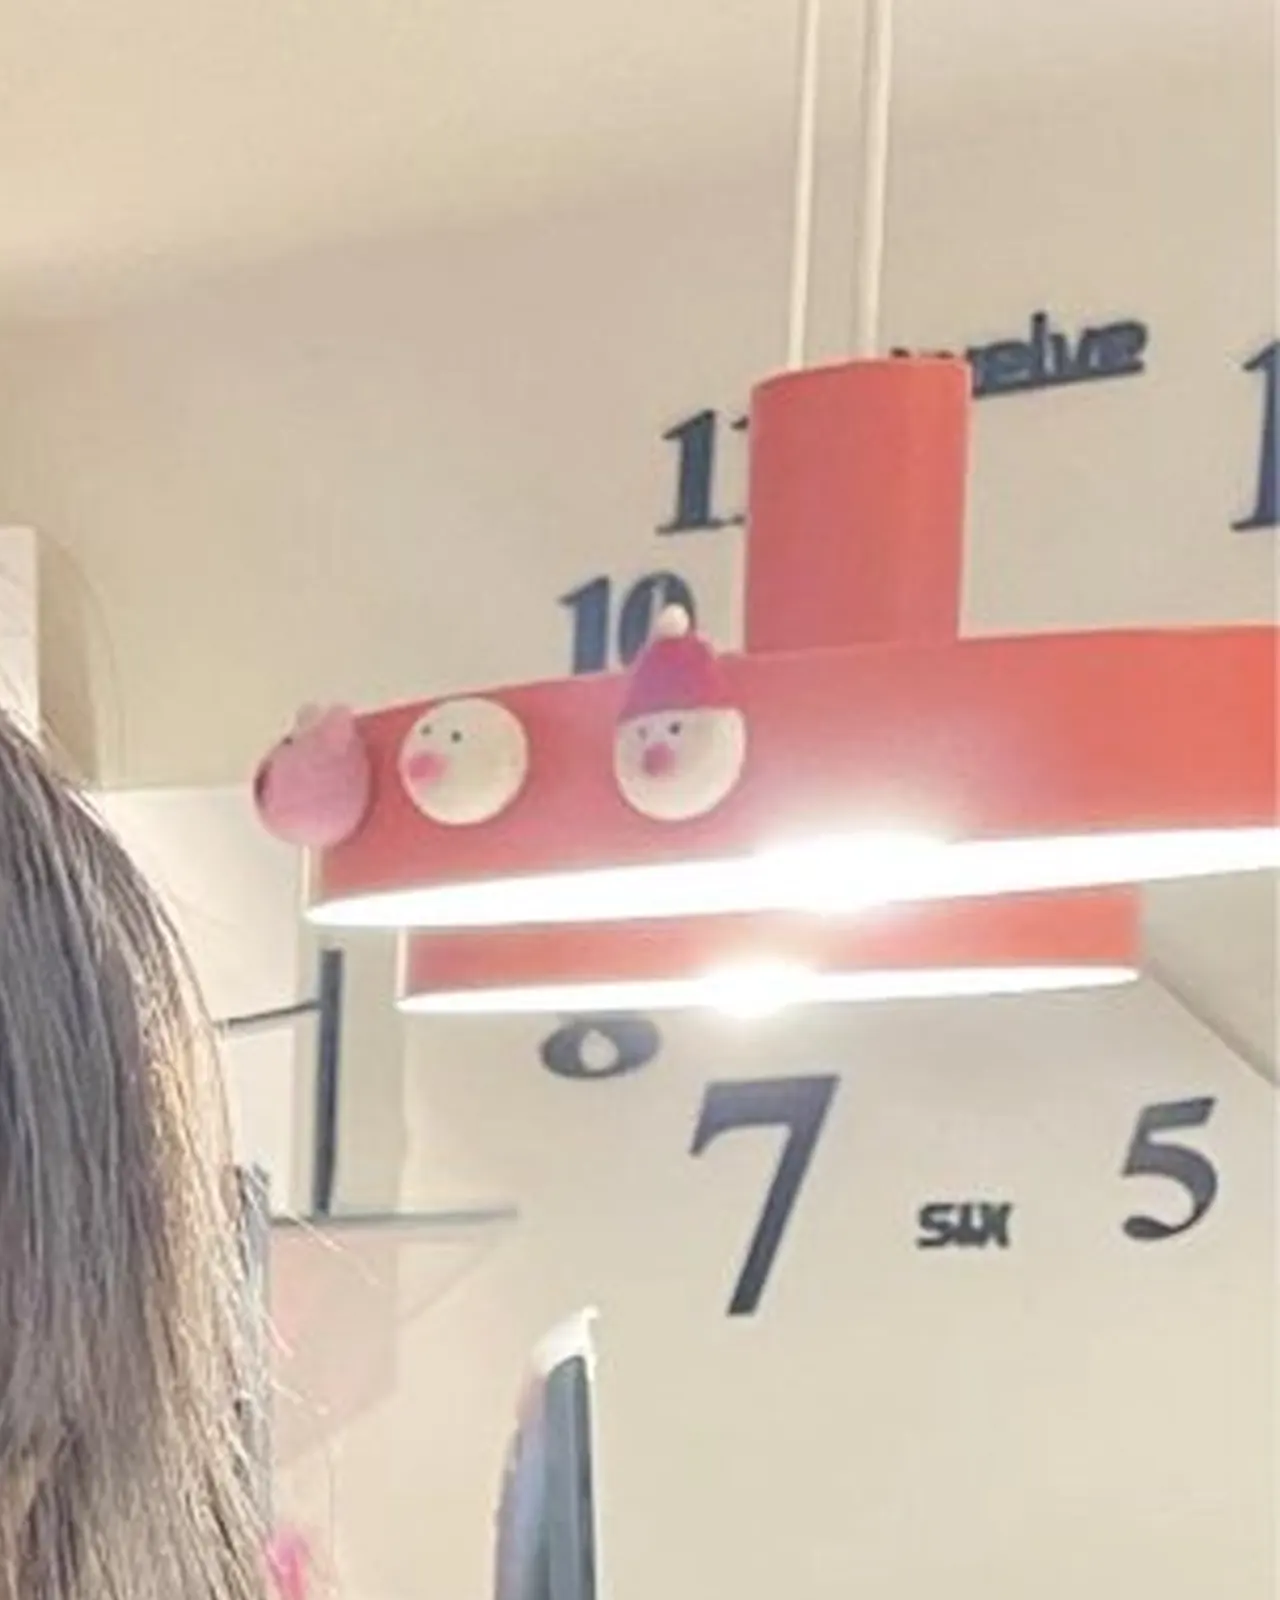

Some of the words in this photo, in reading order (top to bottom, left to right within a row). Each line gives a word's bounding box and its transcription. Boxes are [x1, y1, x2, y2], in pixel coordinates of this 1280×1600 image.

[655, 409, 749, 535] 1
[690, 1074, 840, 1317] 7
[1121, 1097, 1219, 1240] 5
